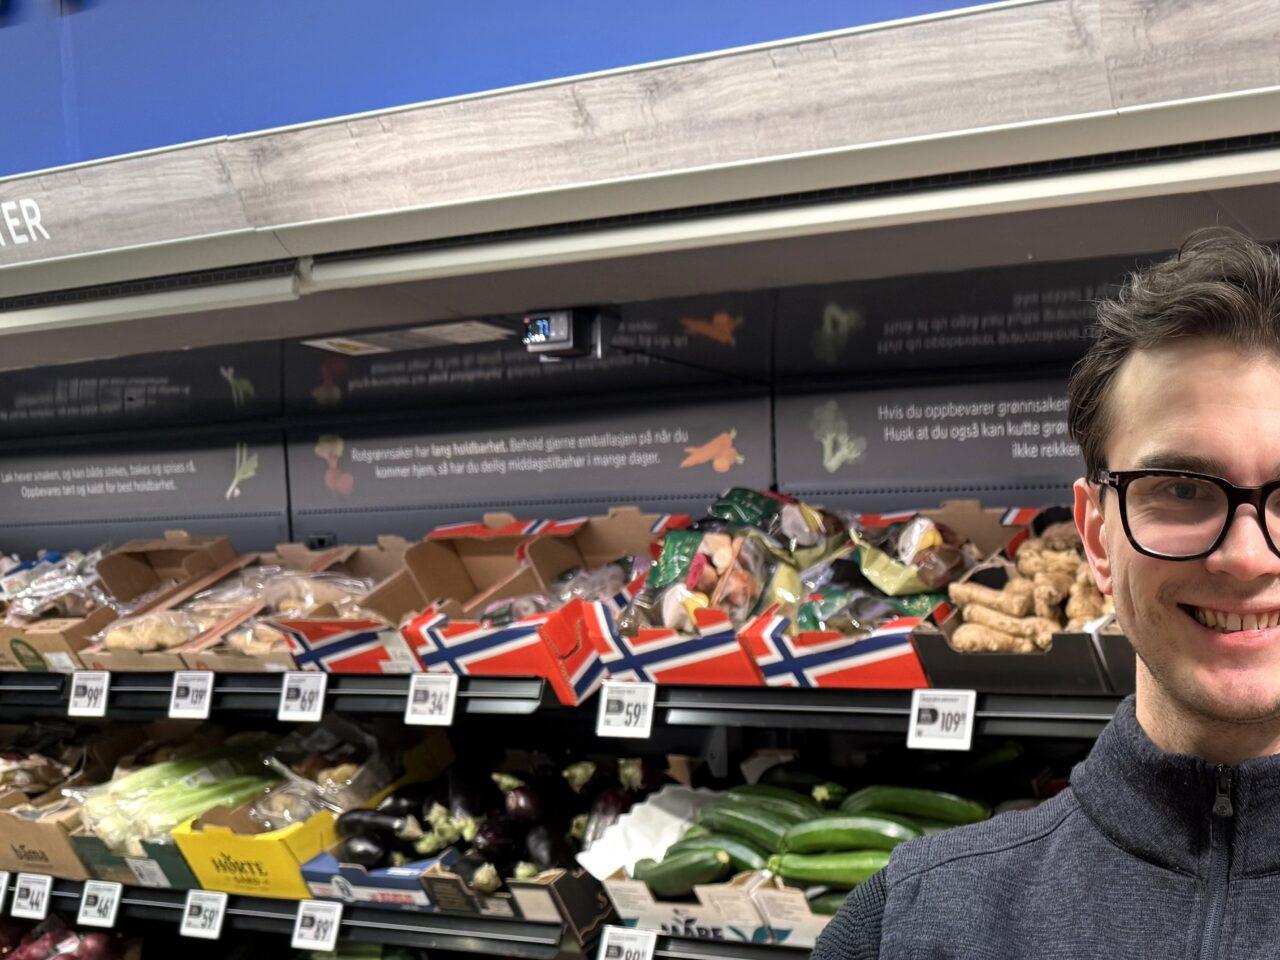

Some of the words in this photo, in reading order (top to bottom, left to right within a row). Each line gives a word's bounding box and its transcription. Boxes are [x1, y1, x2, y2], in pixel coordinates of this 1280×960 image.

[878, 403, 903, 421] Hvis
[906, 403, 923, 418] du
[925, 400, 995, 421] oppbevarer
[884, 425, 915, 442] Husk
[916, 425, 930, 441] at
[931, 424, 949, 441] du
[950, 421, 980, 441] også
[981, 421, 1004, 438] kan
[1007, 420, 1040, 437] kutte
[1011, 442, 1038, 459] ikke
[624, 702, 641, 728] 59
[941, 712, 961, 733] 109
